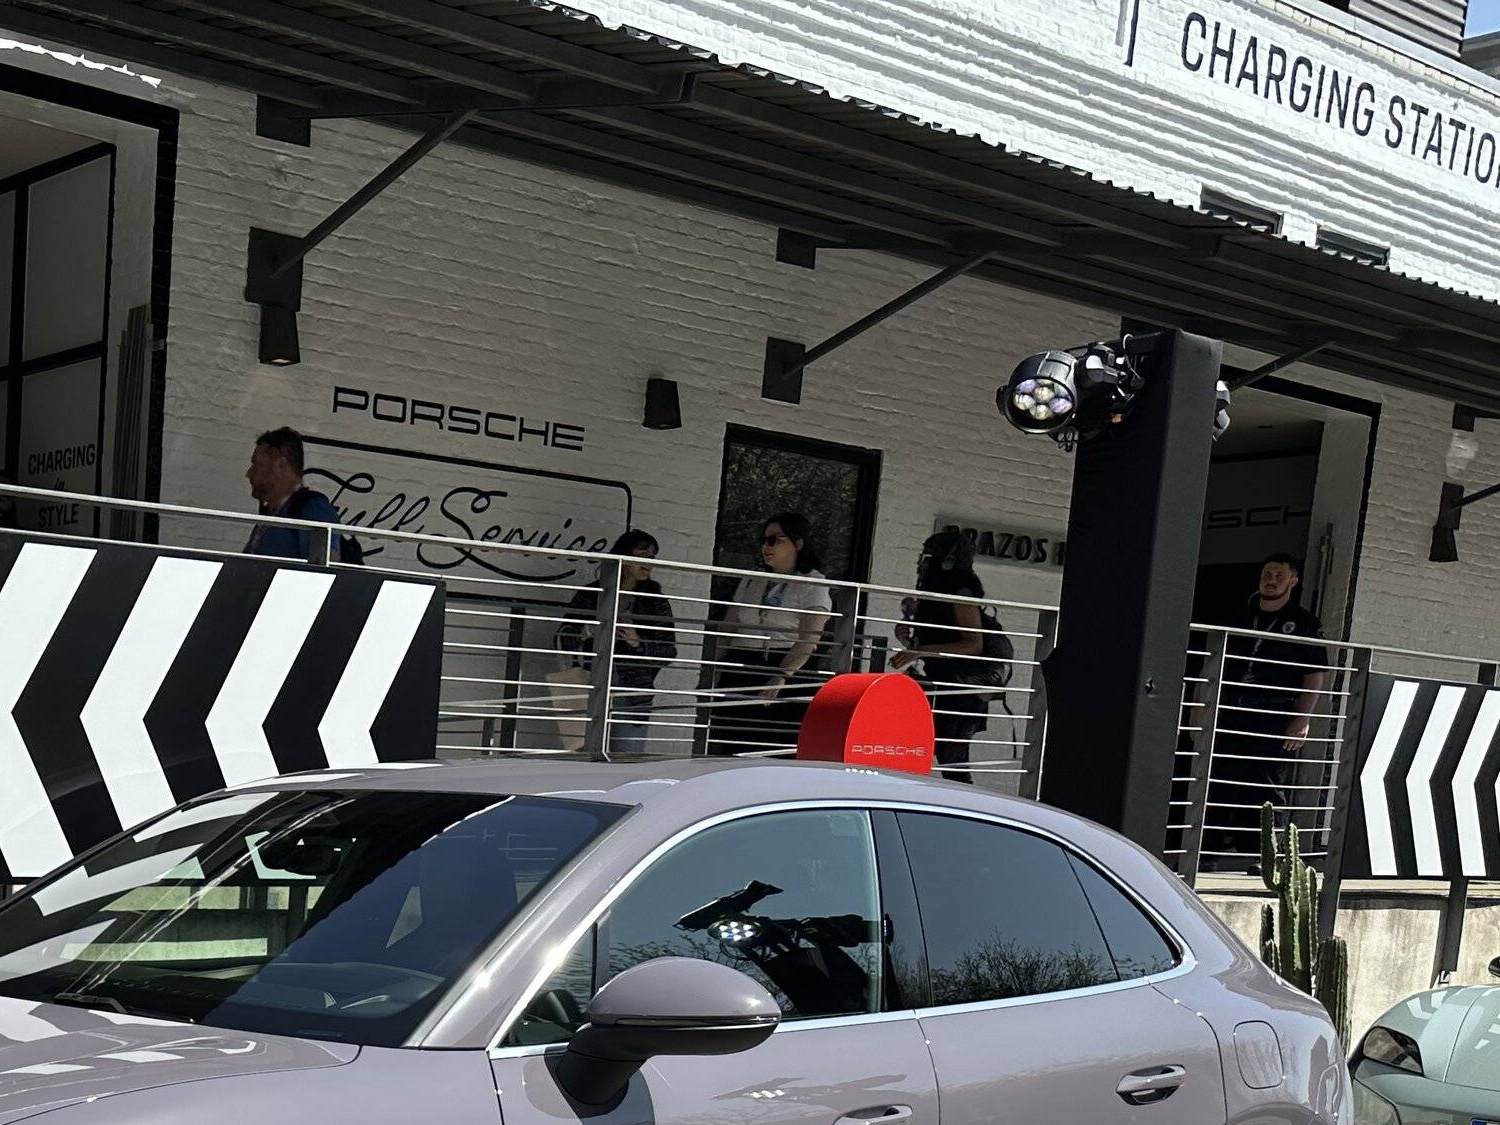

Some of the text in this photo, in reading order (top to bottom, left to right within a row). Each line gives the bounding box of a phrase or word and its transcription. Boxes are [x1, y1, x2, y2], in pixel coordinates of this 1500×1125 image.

[1181, 11, 1500, 189] CHARGING STATIO
[331, 385, 586, 452] PORSCHE
[27, 443, 97, 476] CHARGING
[37, 502, 80, 530] STYLE
[851, 744, 927, 758] PORSCHE
